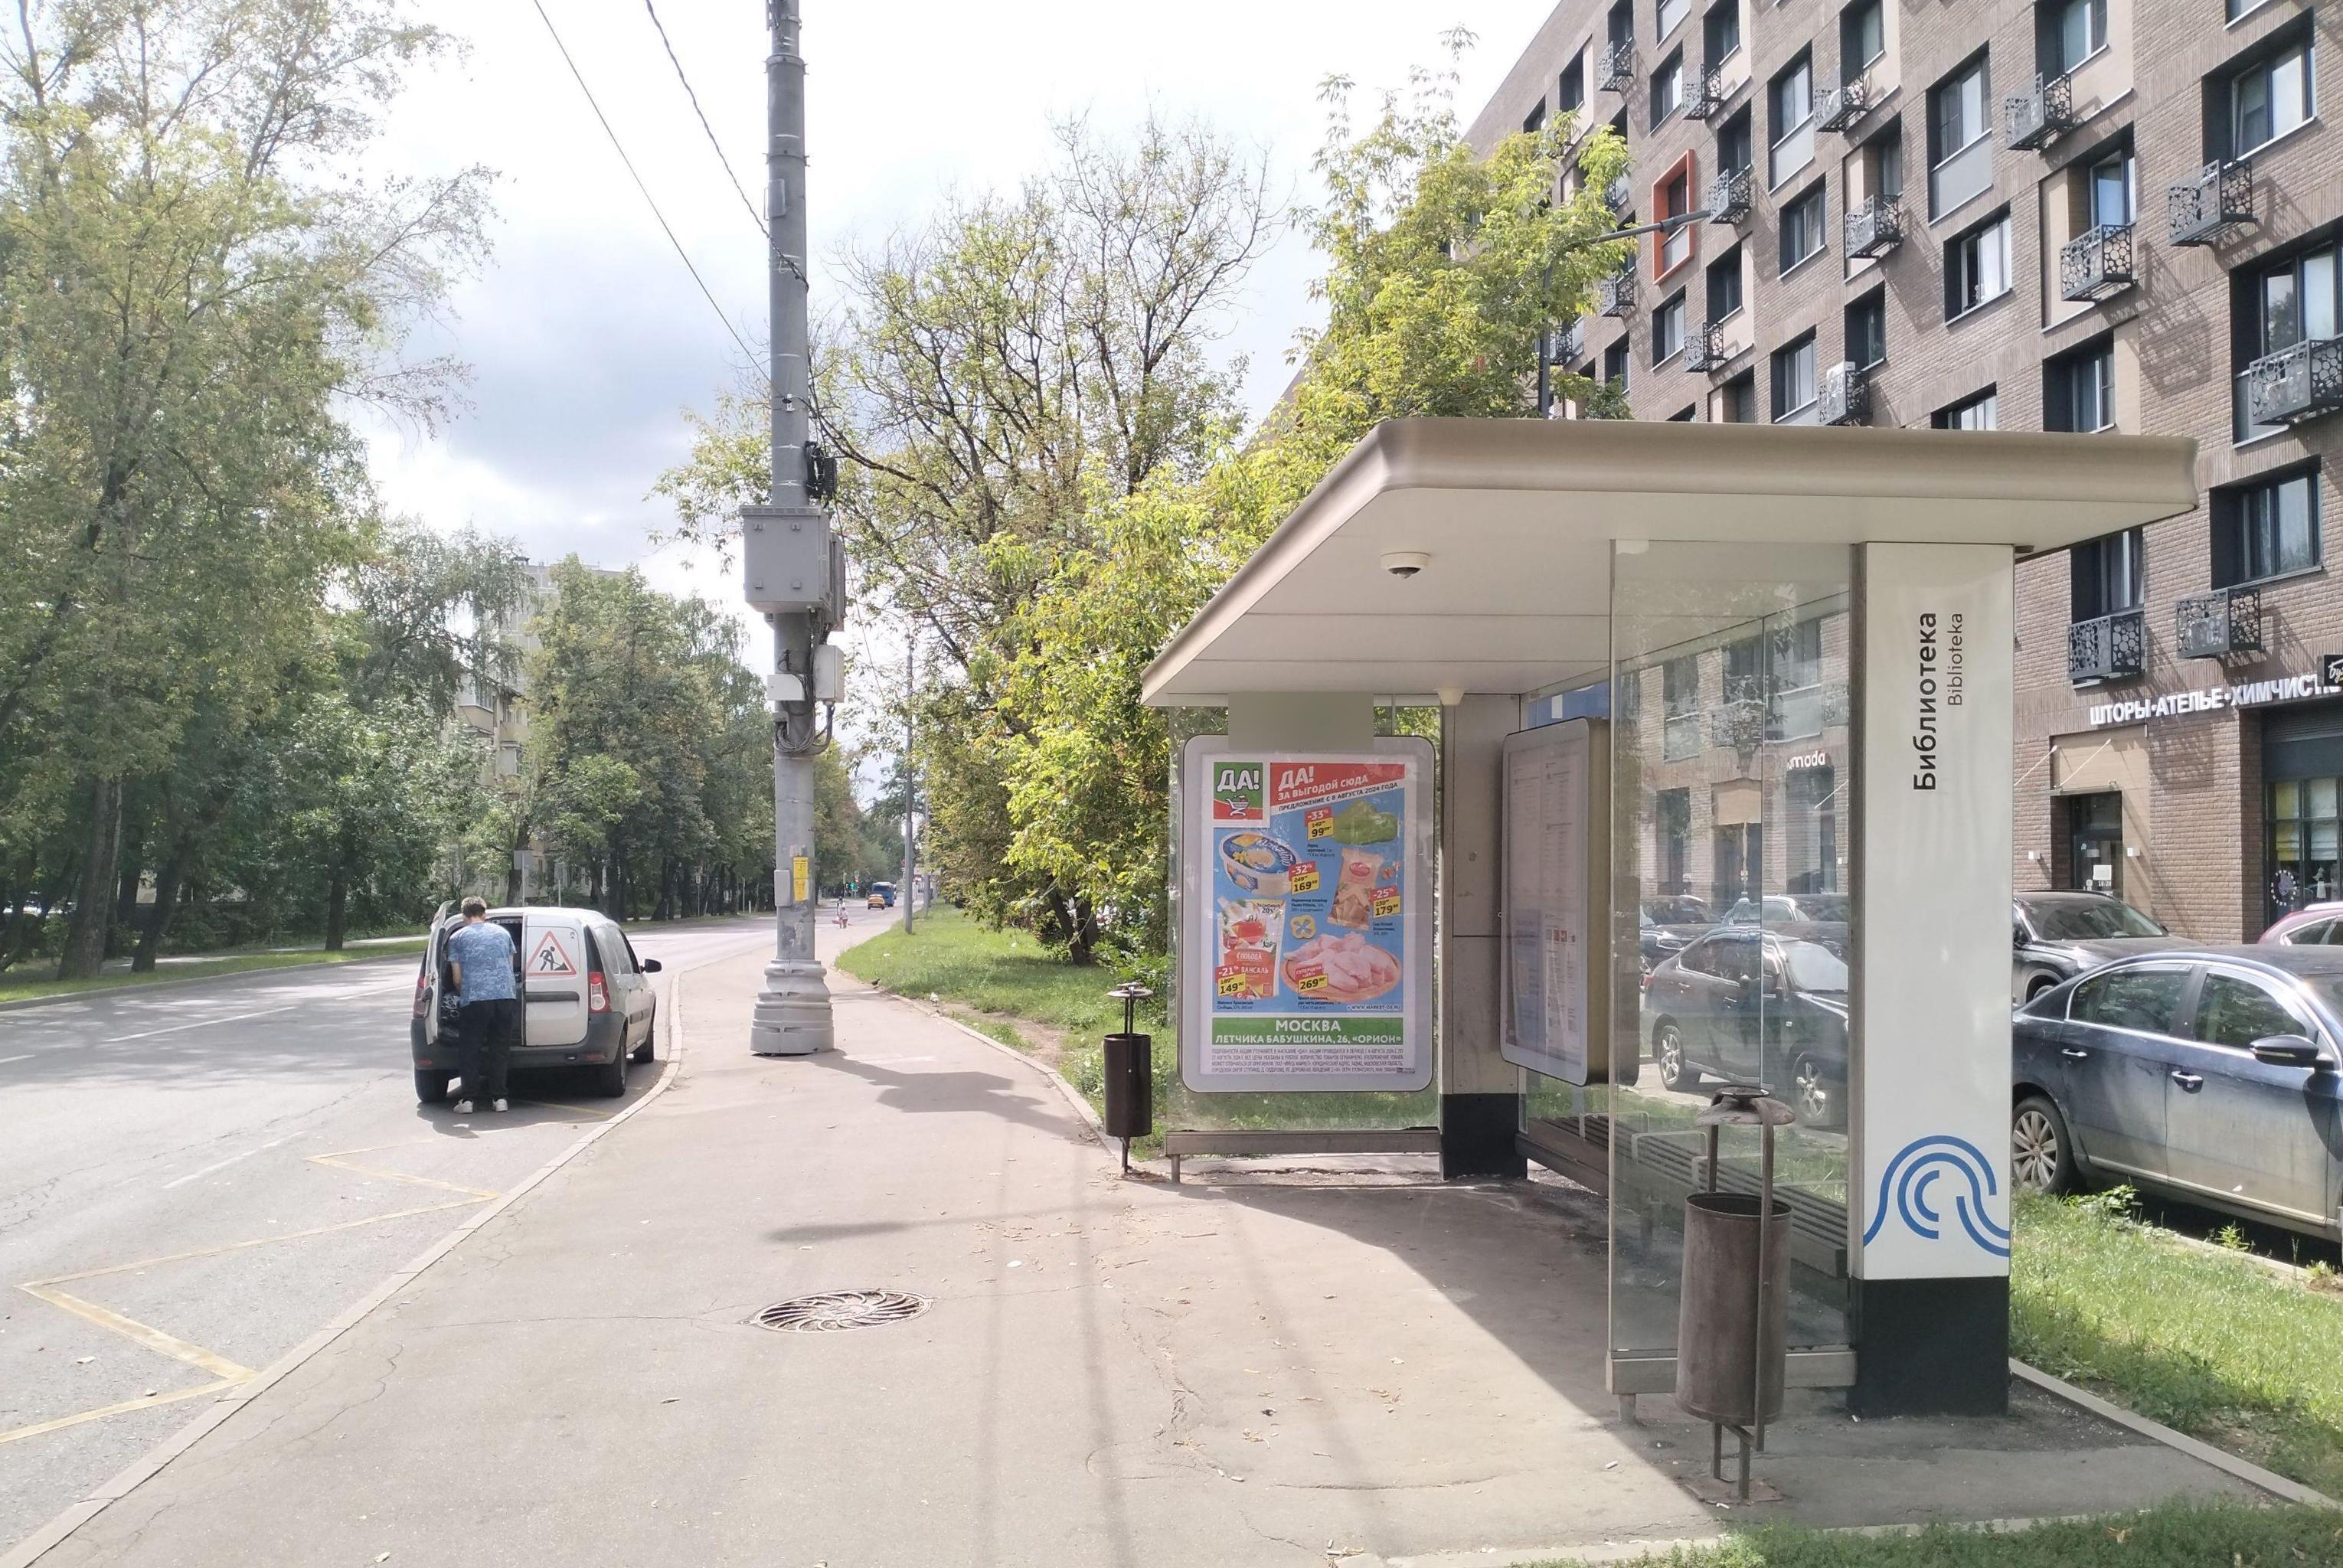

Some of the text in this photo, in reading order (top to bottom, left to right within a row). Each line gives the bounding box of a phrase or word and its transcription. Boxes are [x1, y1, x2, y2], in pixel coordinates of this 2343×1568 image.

[1946, 613, 1962, 705] Biblioteka
[1913, 612, 1936, 790] Библиотека
[2090, 699, 2152, 725] ШТОРЫ
[1217, 769, 1260, 792] ДА!
[1277, 766, 1314, 791] ДА!
[1278, 775, 1368, 801] ЗА ВЫГОДОЙ СЮДА
[1279, 798, 1325, 812] ПРЕДЛОЖЕНИЕ
[1338, 789, 1363, 799] АВГУСТА
[1381, 782, 1397, 791] ГОДА
[1215, 1034, 1264, 1044] ЛЕТЧИКА
[1266, 1034, 1335, 1044] БАБУШКИНА,
[1352, 1034, 1401, 1044] «ОРИОН»
[1276, 1020, 1341, 1032] МОСКВА
